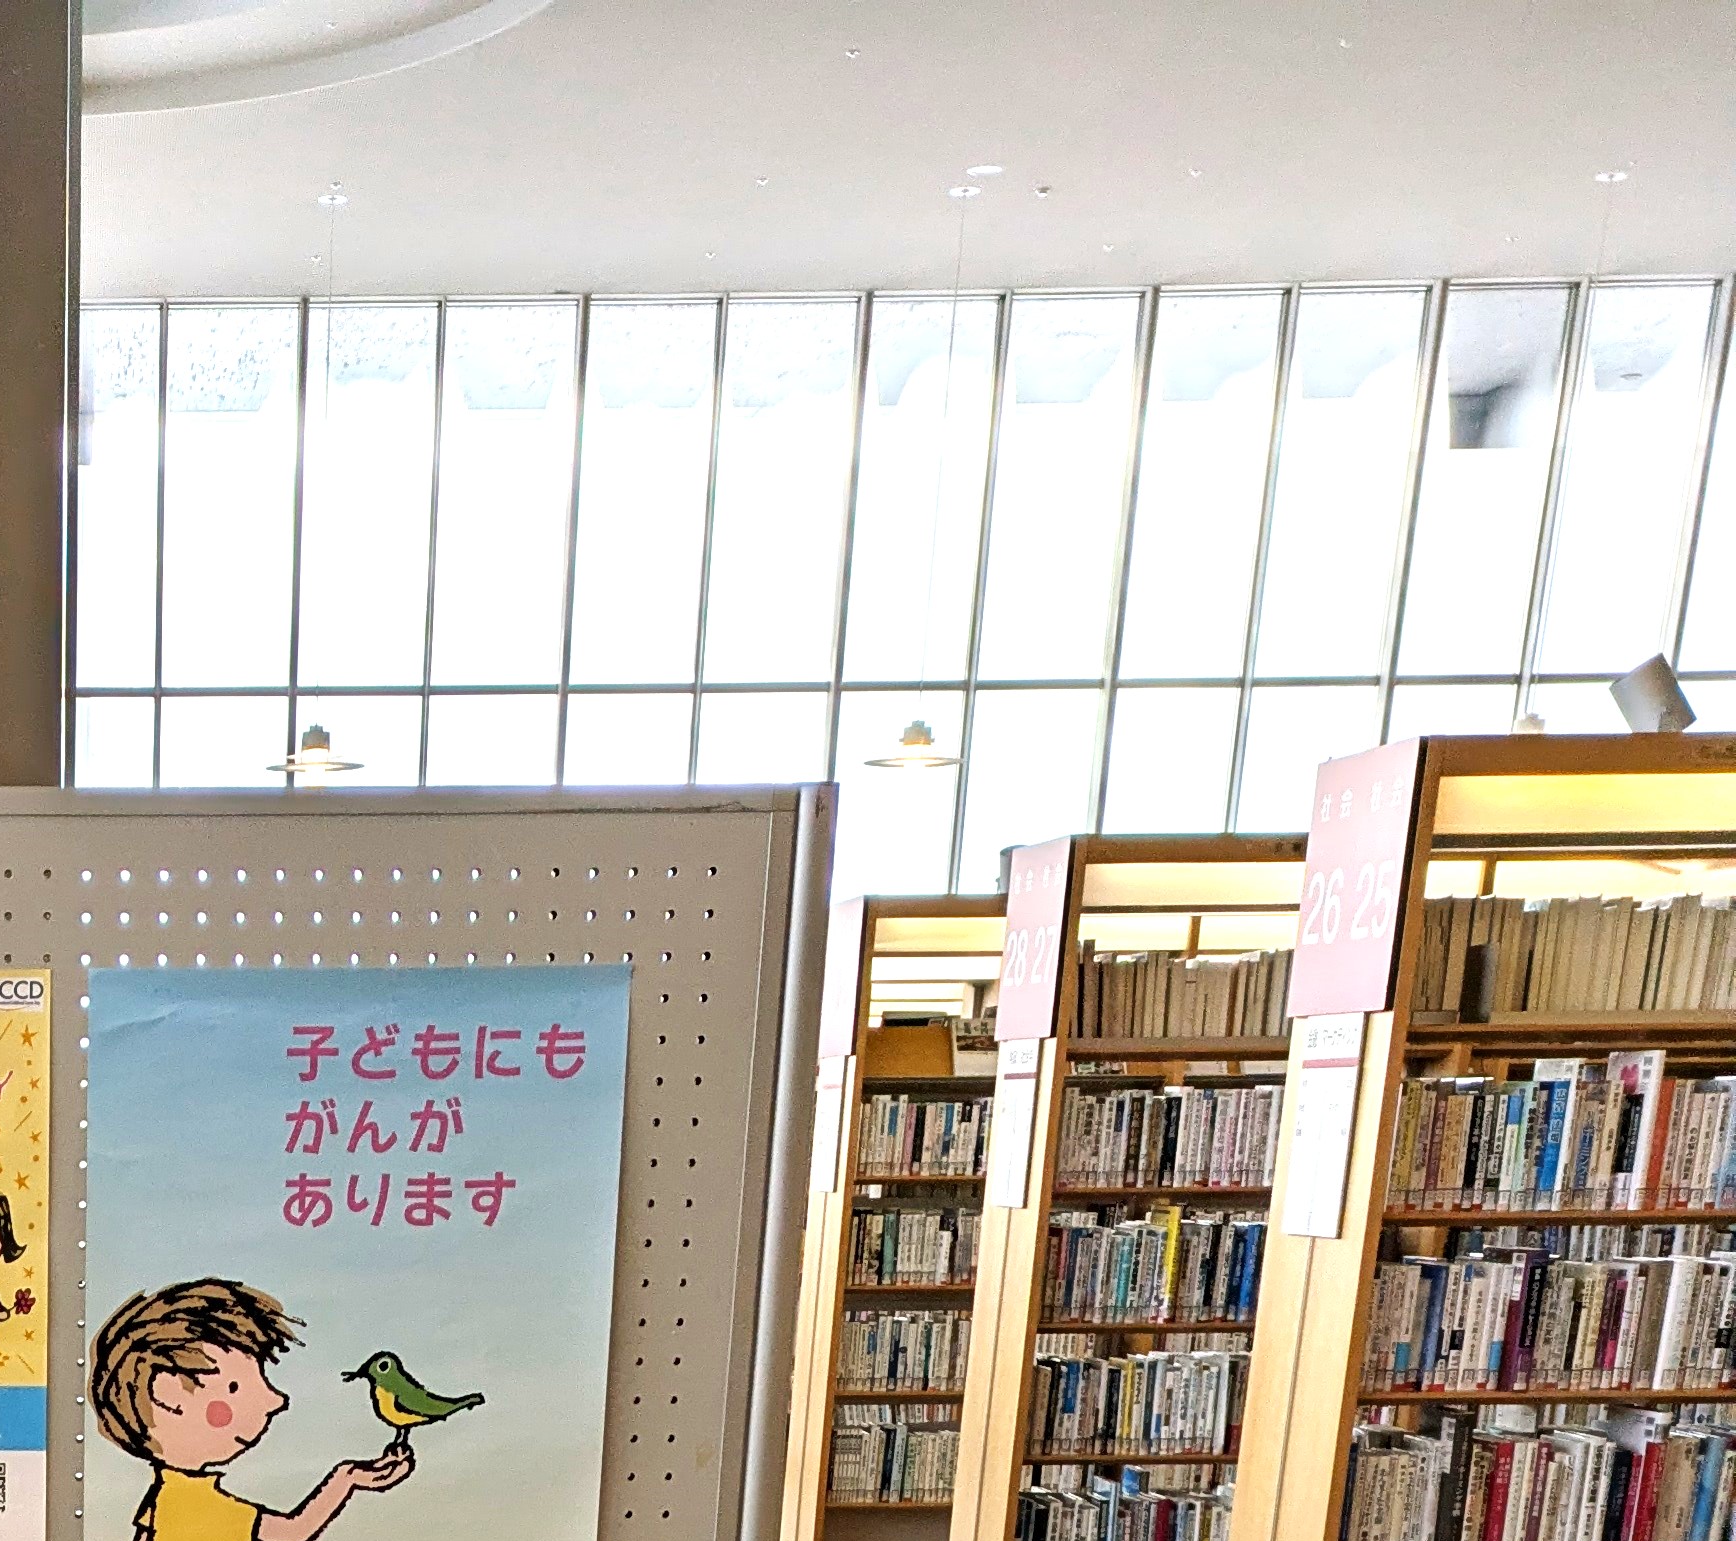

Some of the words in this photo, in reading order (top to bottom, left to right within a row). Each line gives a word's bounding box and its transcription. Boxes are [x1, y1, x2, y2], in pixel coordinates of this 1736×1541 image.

[1320, 790, 1353, 822] 社会
[1302, 867, 1343, 947] 26
[1350, 859, 1396, 939] 25
[1003, 929, 1027, 988] 28
[1031, 926, 1056, 984] 27
[286, 1023, 586, 1082] 子どもにも
[285, 1096, 464, 1155] がんが
[283, 1171, 516, 1227] あります
